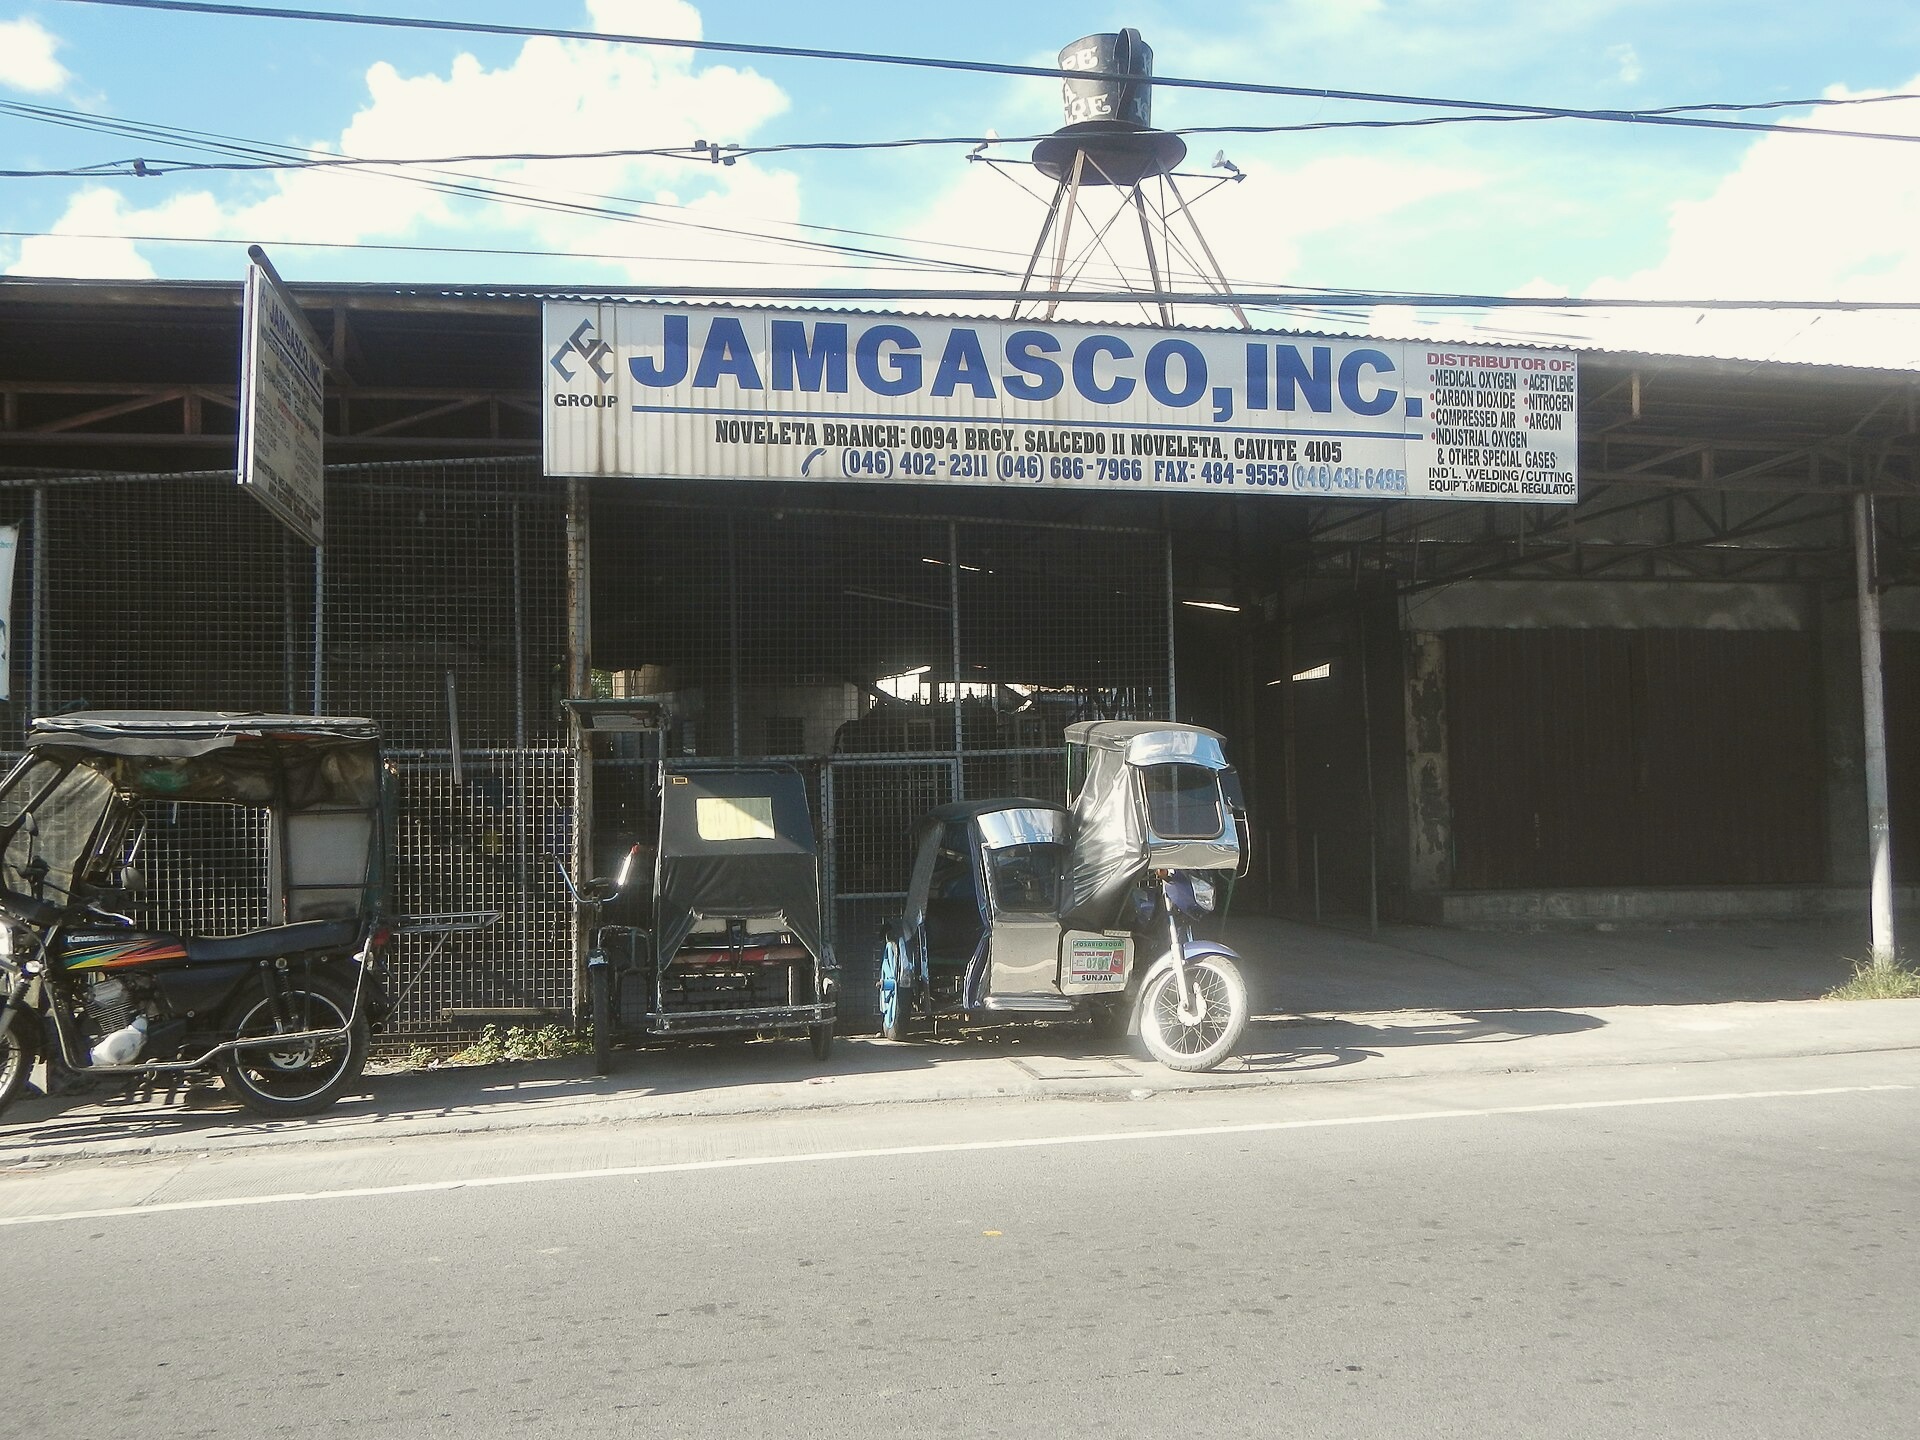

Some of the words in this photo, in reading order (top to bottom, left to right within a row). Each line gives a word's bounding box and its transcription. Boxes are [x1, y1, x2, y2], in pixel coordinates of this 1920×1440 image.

[1427, 352, 1546, 371] DISTRIBUTOR
[1549, 359, 1575, 371] OF:
[1435, 369, 1476, 388] MEDICAL
[1479, 371, 1516, 390] OXYGEN
[1528, 374, 1574, 392] ACETYLENE
[554, 393, 618, 408] GROUP
[1435, 389, 1473, 407] CARBON
[1477, 391, 1516, 409] DIOXIDE
[1528, 393, 1574, 412] NITROGEN
[1436, 408, 1497, 428] COMPRESSED
[1500, 411, 1516, 429] AIR
[1529, 413, 1562, 431] ARGON
[715, 419, 817, 446] NOVELETA
[822, 423, 906, 448] BRANCH:
[910, 425, 958, 450] 0094
[964, 428, 1019, 452] BRGY.
[1024, 430, 1106, 455] SALCEDO
[1112, 433, 1125, 455] II
[1131, 434, 1229, 461] NOVELETA,
[1234, 437, 1297, 461] CAVITE
[1304, 440, 1342, 463] 4105
[1435, 428, 1489, 447] INDUSTRIAL
[1491, 430, 1528, 448] OXYGEN
[842, 447, 894, 479] (046)
[996, 451, 1045, 483] (046)
[1154, 460, 1196, 483] FAX:
[1437, 448, 1445, 465] &
[1448, 449, 1480, 467] OTHER
[1483, 450, 1522, 468] SPECIAL
[1525, 451, 1556, 469] GASES
